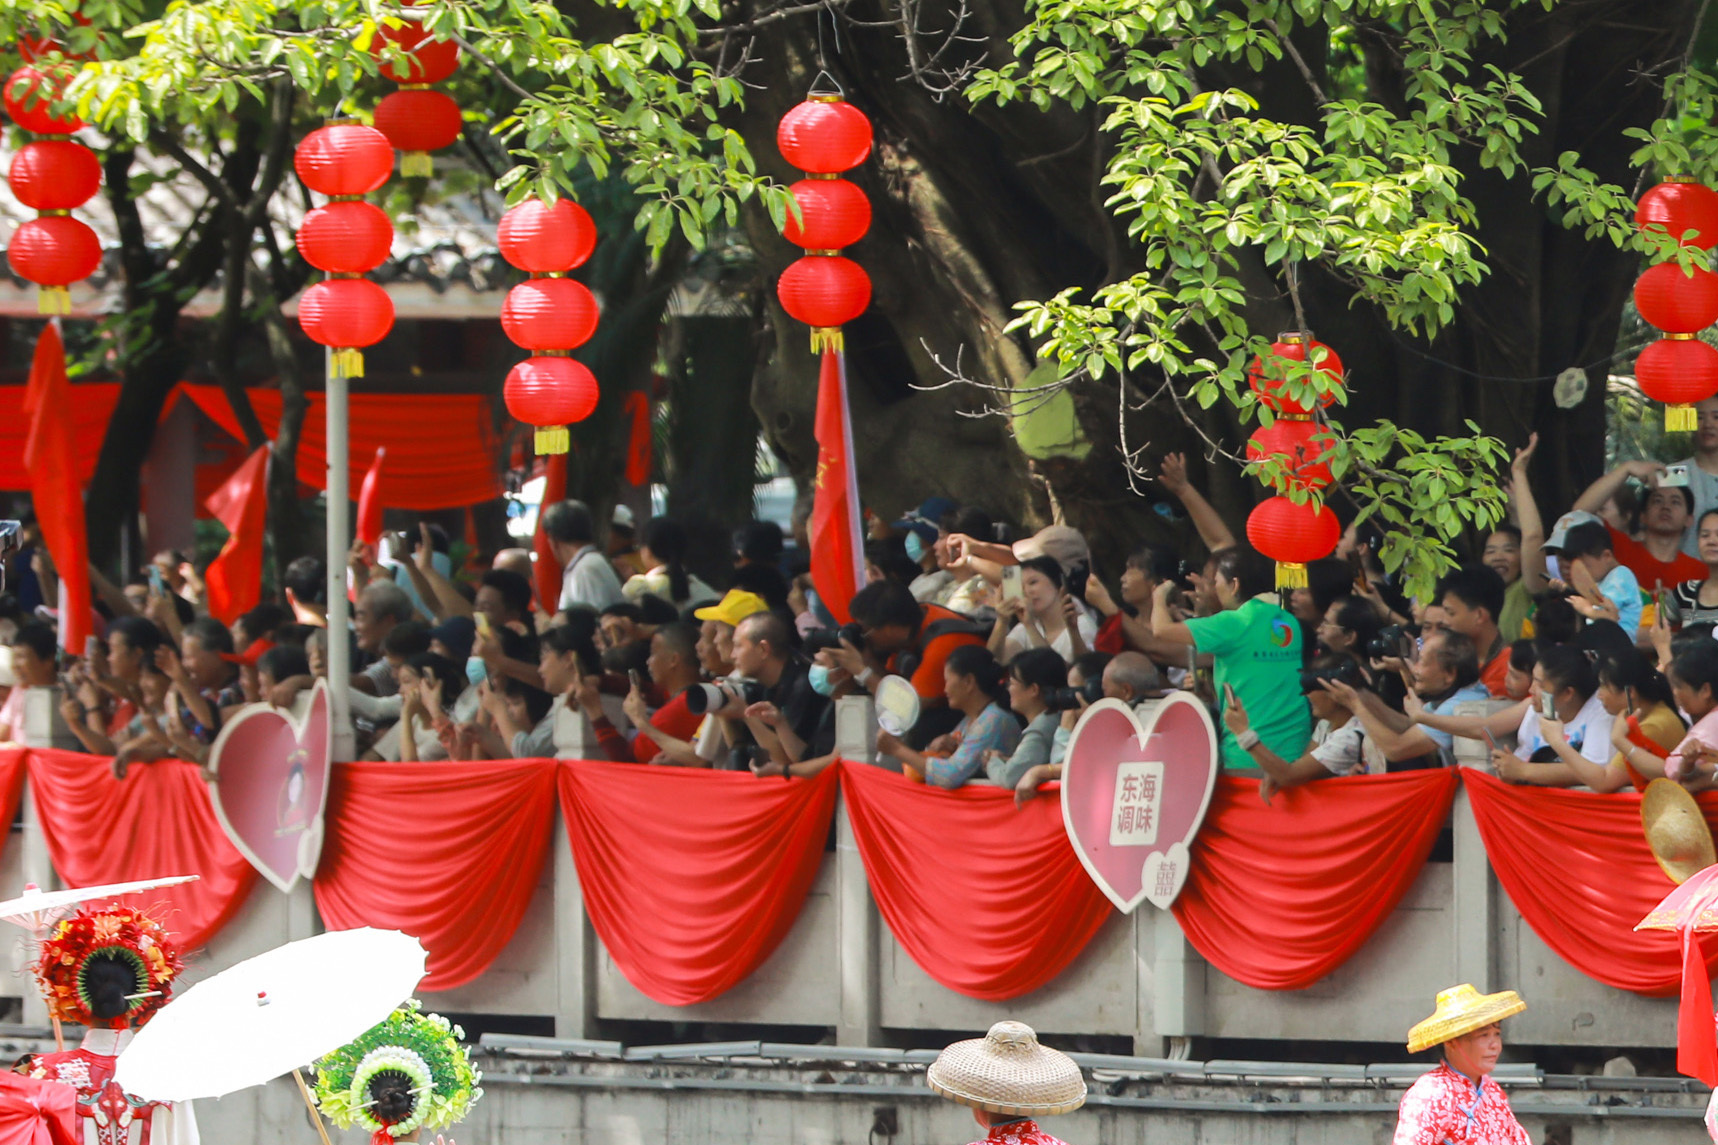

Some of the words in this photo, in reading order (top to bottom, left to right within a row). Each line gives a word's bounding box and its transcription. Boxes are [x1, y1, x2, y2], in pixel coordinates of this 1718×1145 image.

[1120, 773, 1157, 803] 东海
[1117, 805, 1153, 834] 调味
[1154, 861, 1177, 897] 囍
